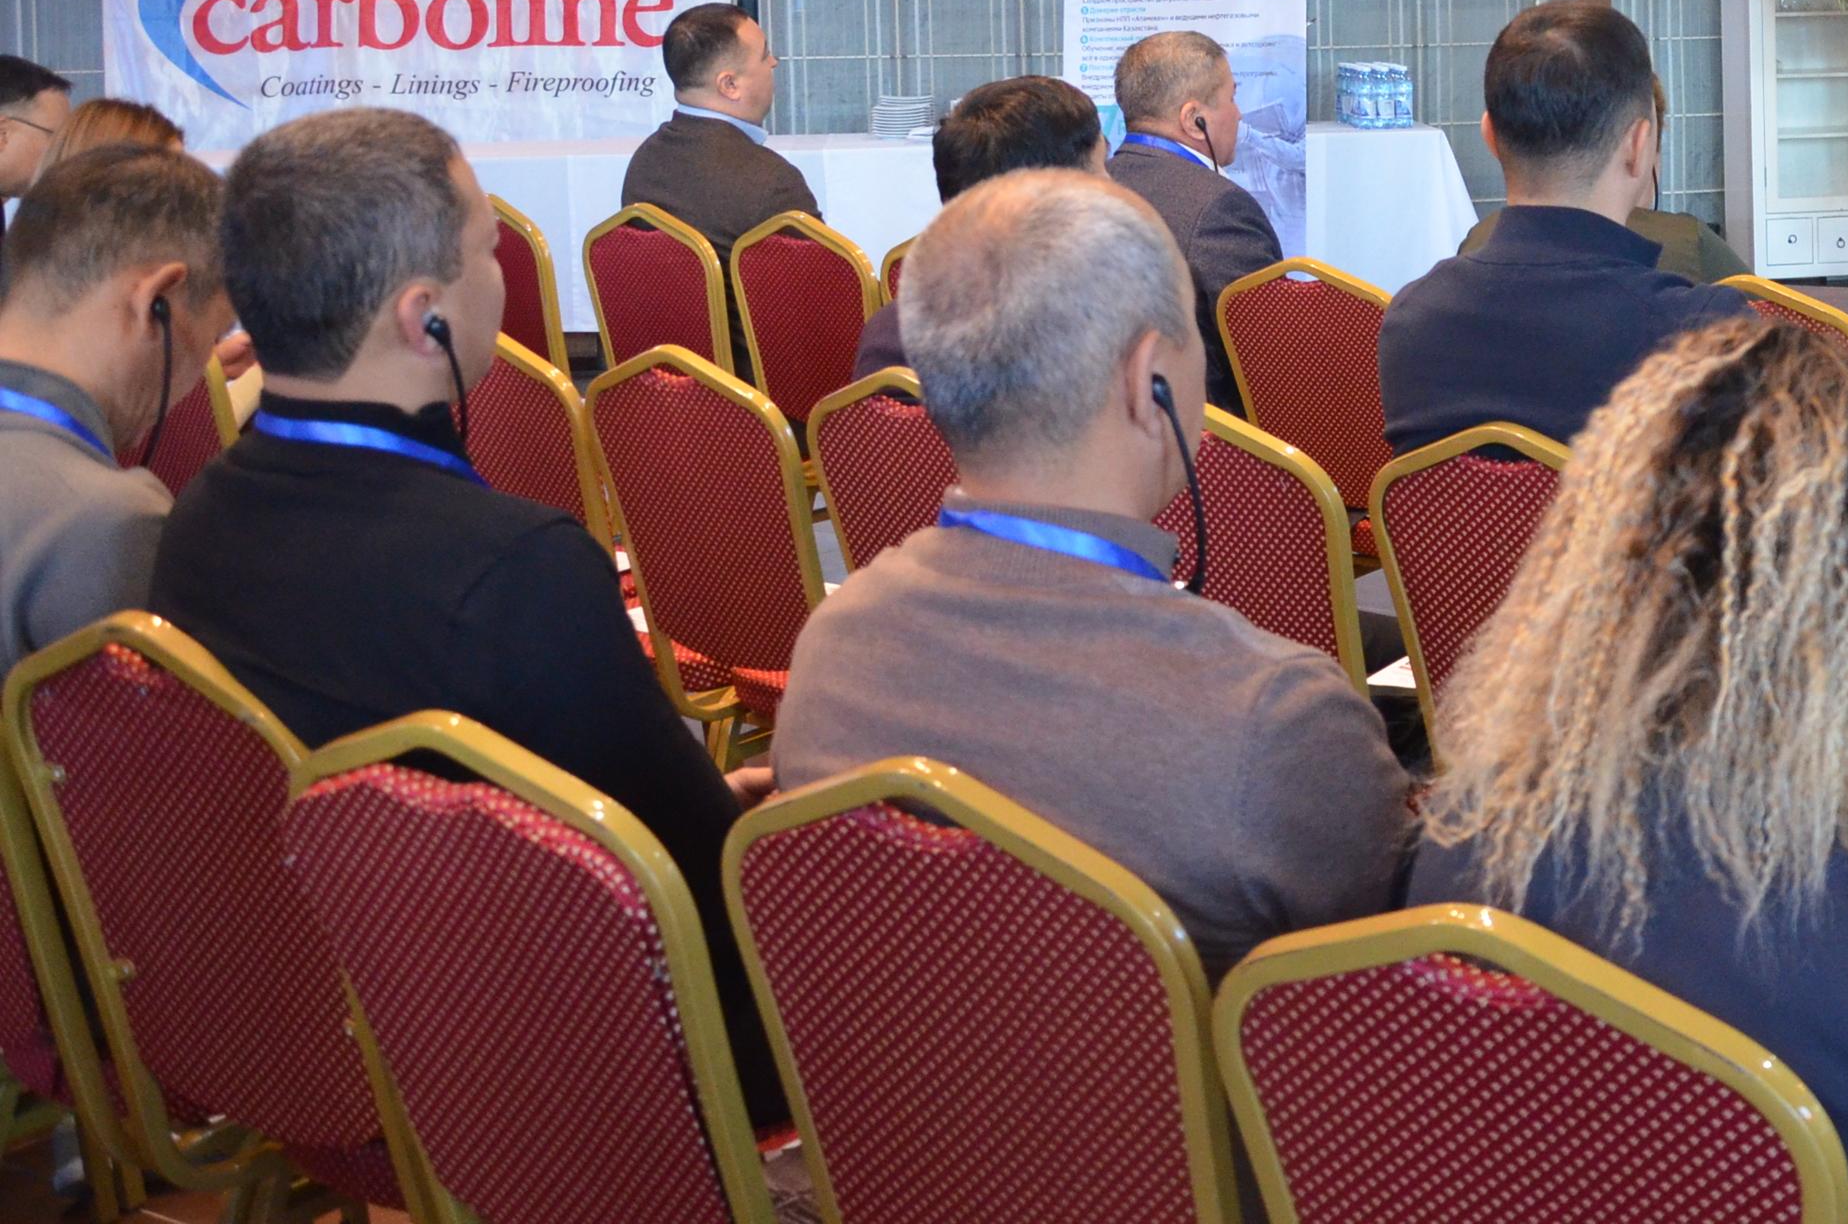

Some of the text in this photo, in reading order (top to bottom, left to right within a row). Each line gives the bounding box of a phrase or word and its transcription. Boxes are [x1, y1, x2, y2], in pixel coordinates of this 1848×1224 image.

[261, 73, 363, 100] Coatings
[390, 72, 480, 101] Linings
[506, 70, 656, 99] Fireproofing
